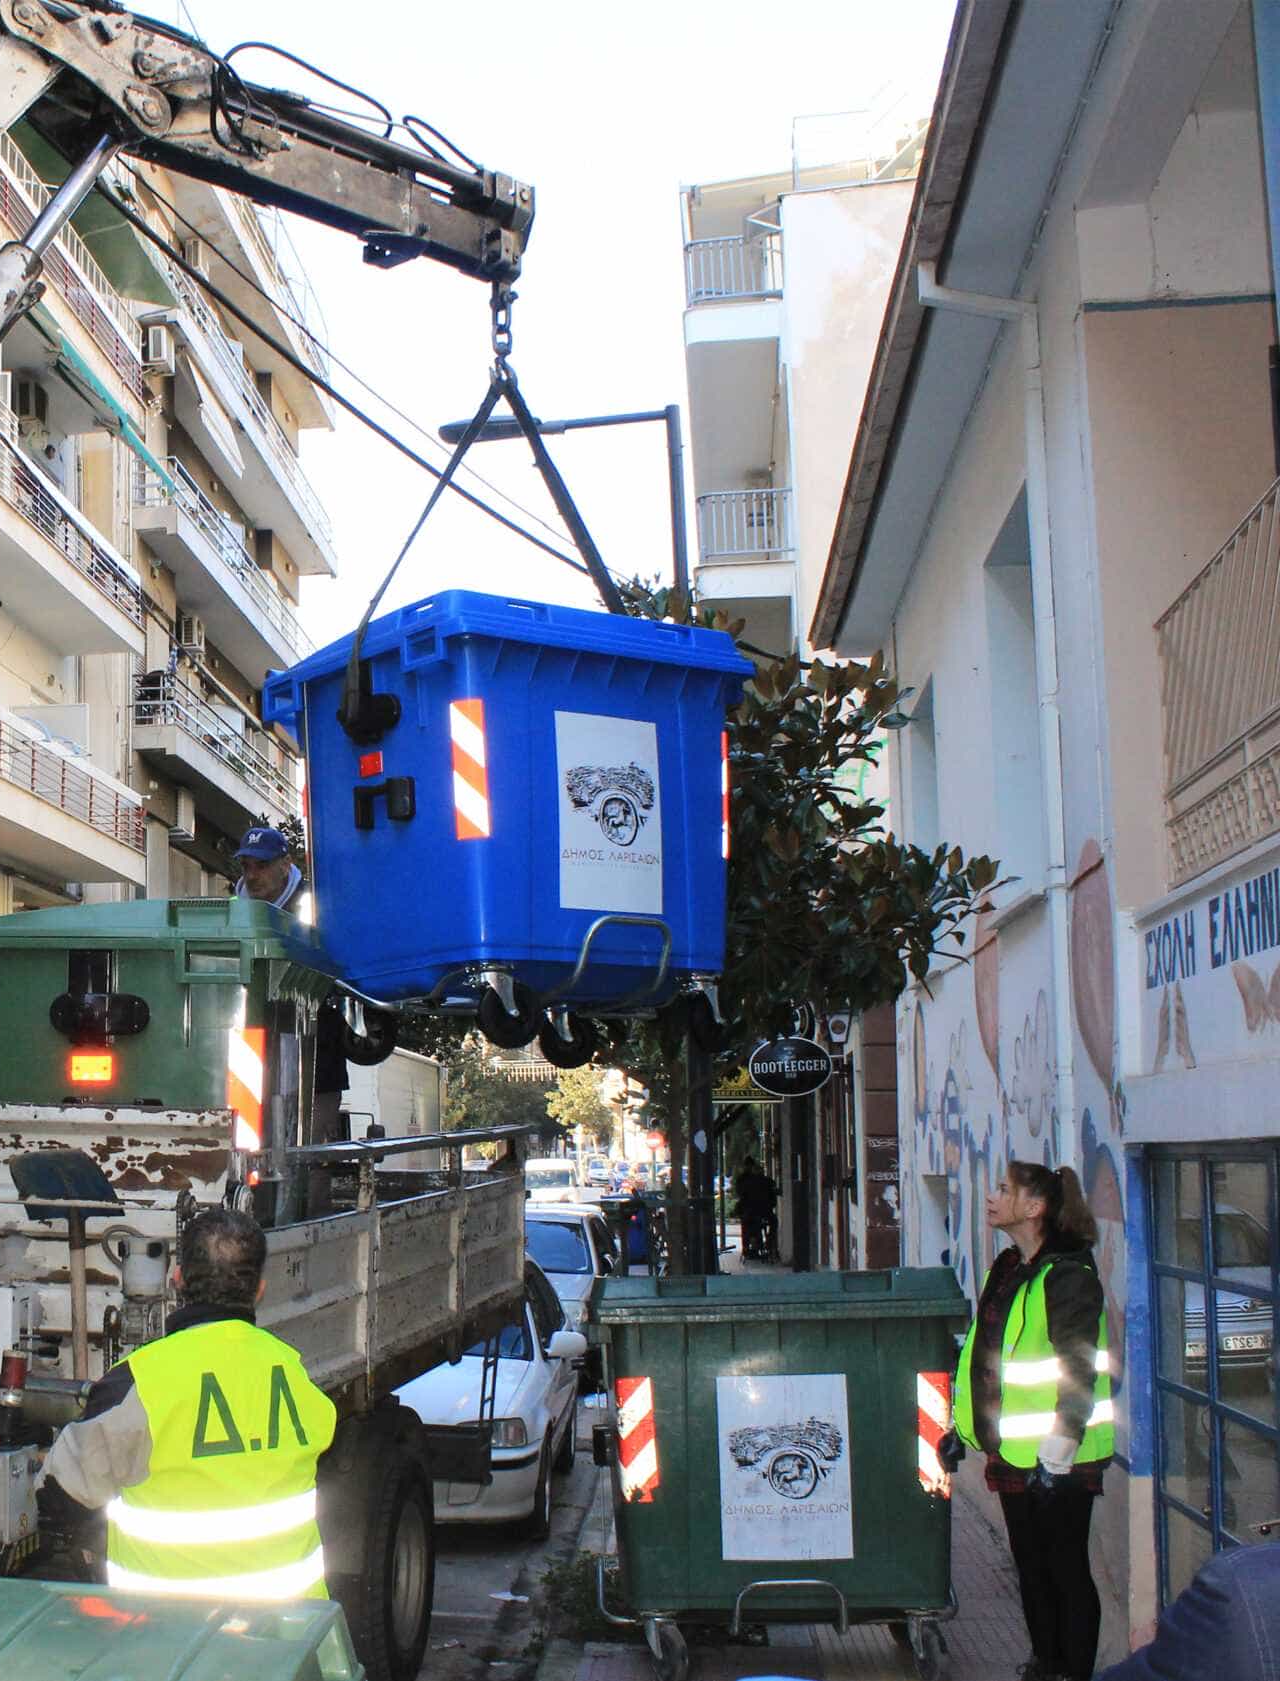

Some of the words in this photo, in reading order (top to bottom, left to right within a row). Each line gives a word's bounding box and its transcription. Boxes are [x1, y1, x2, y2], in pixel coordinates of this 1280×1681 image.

[562, 850, 604, 861] ΔΗΜΟΣ
[1144, 910, 1196, 989] ΣΧΟΛΗ
[753, 1059, 827, 1074] BOOTLEGGER
[726, 1504, 773, 1515] ΔΗΜΟΣ
[780, 1503, 849, 1514] ΛΑΡΙΣΑΙΩΝ
